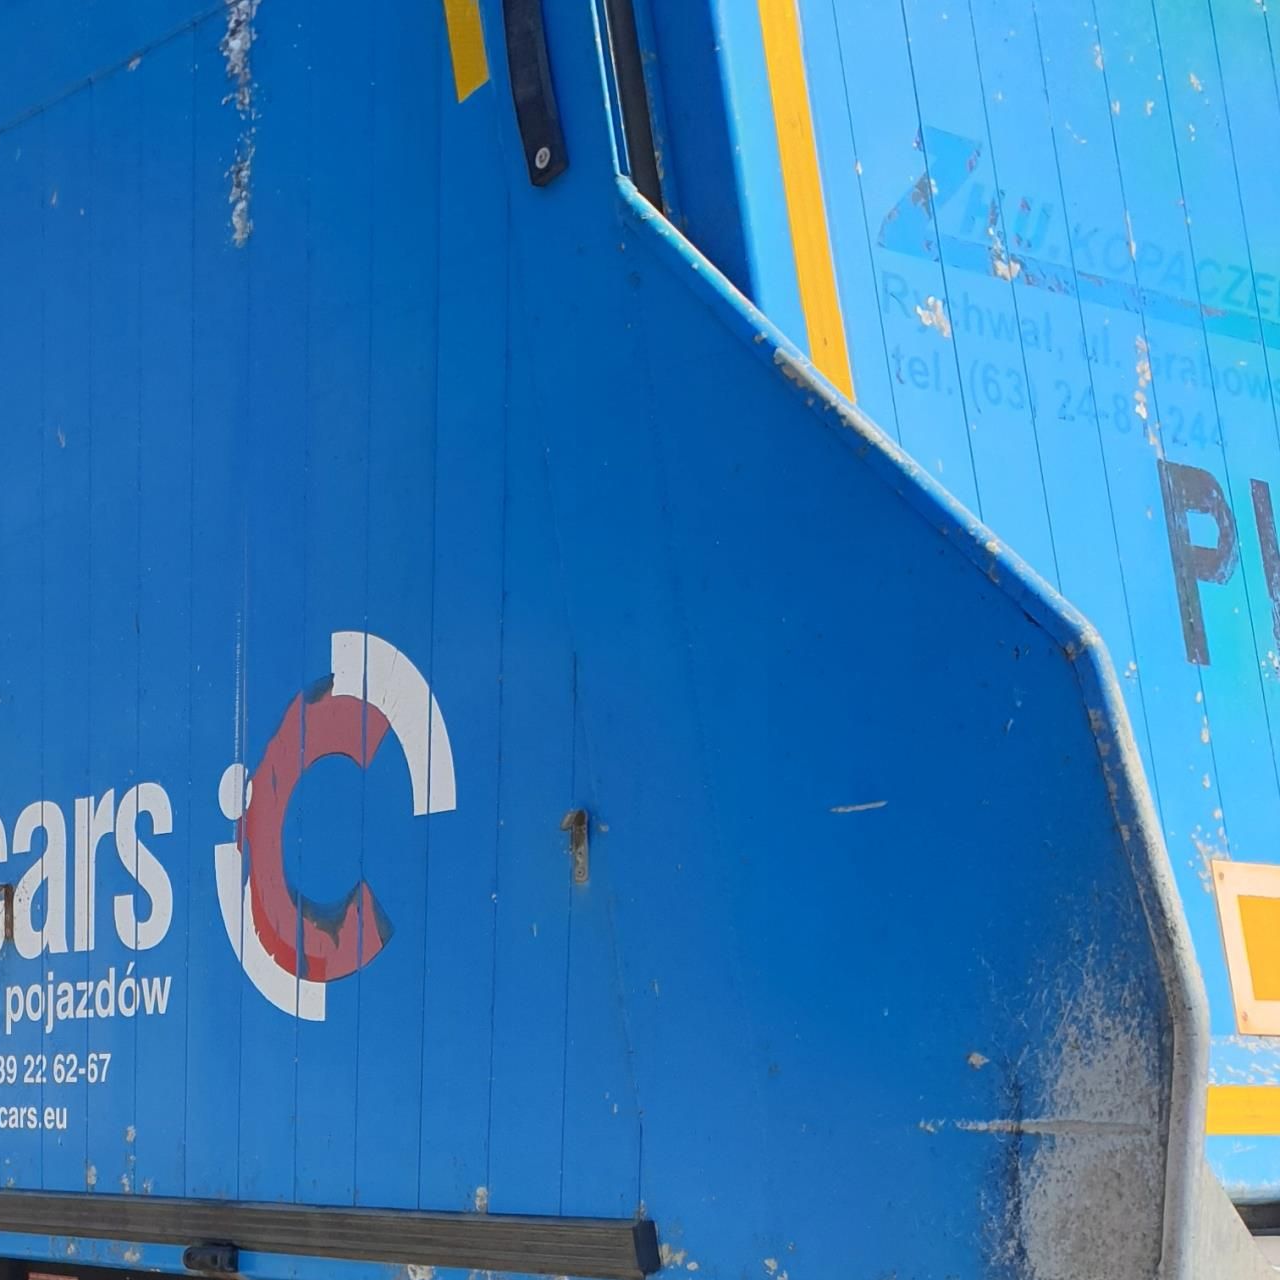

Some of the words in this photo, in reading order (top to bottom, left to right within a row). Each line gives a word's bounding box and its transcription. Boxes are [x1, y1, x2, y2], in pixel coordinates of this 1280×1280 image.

[1073, 224, 1280, 317] KOPACZE
[6, 961, 172, 1035] pojazdów
[23, 1054, 47, 1084] 22
[53, 1053, 112, 1084] 62-67
